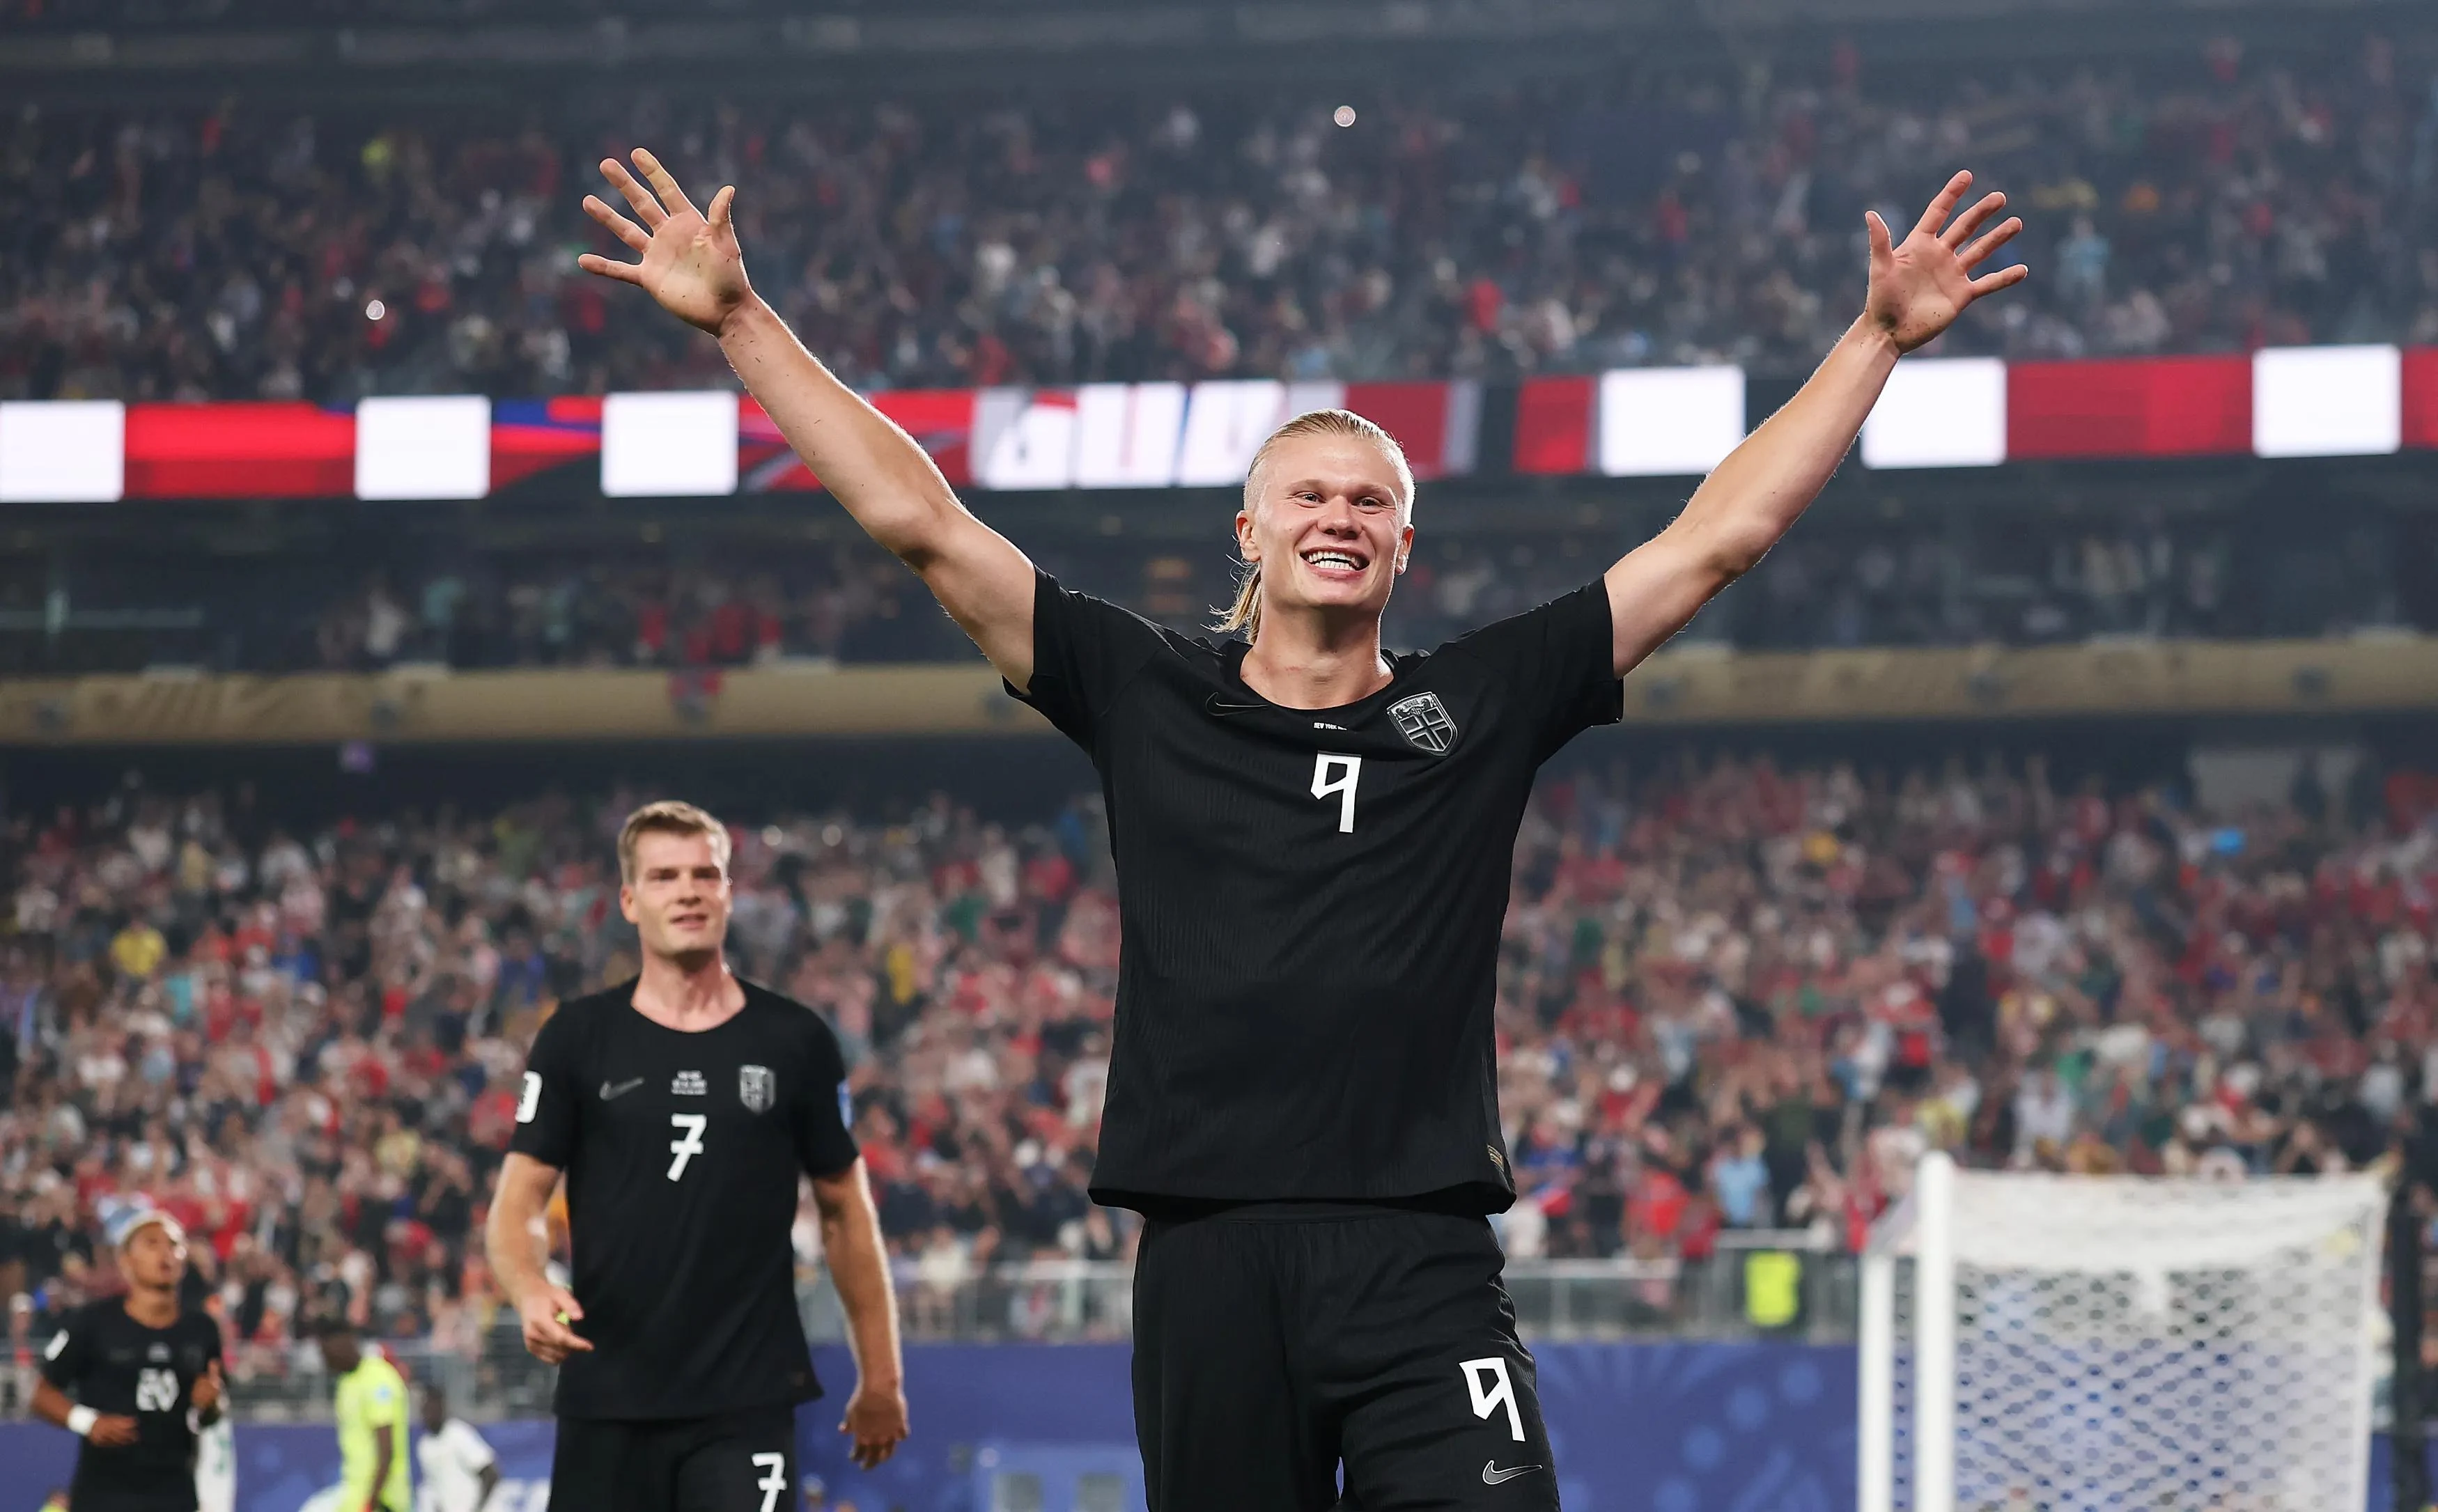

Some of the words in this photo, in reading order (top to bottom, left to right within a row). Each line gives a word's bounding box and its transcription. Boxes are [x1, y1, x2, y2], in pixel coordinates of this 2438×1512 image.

[1311, 750, 1362, 834] 9
[667, 1113, 707, 1183] 7
[137, 1368, 180, 1412] 20
[1459, 1357, 1526, 1442] 9
[752, 1452, 787, 1512] 7
